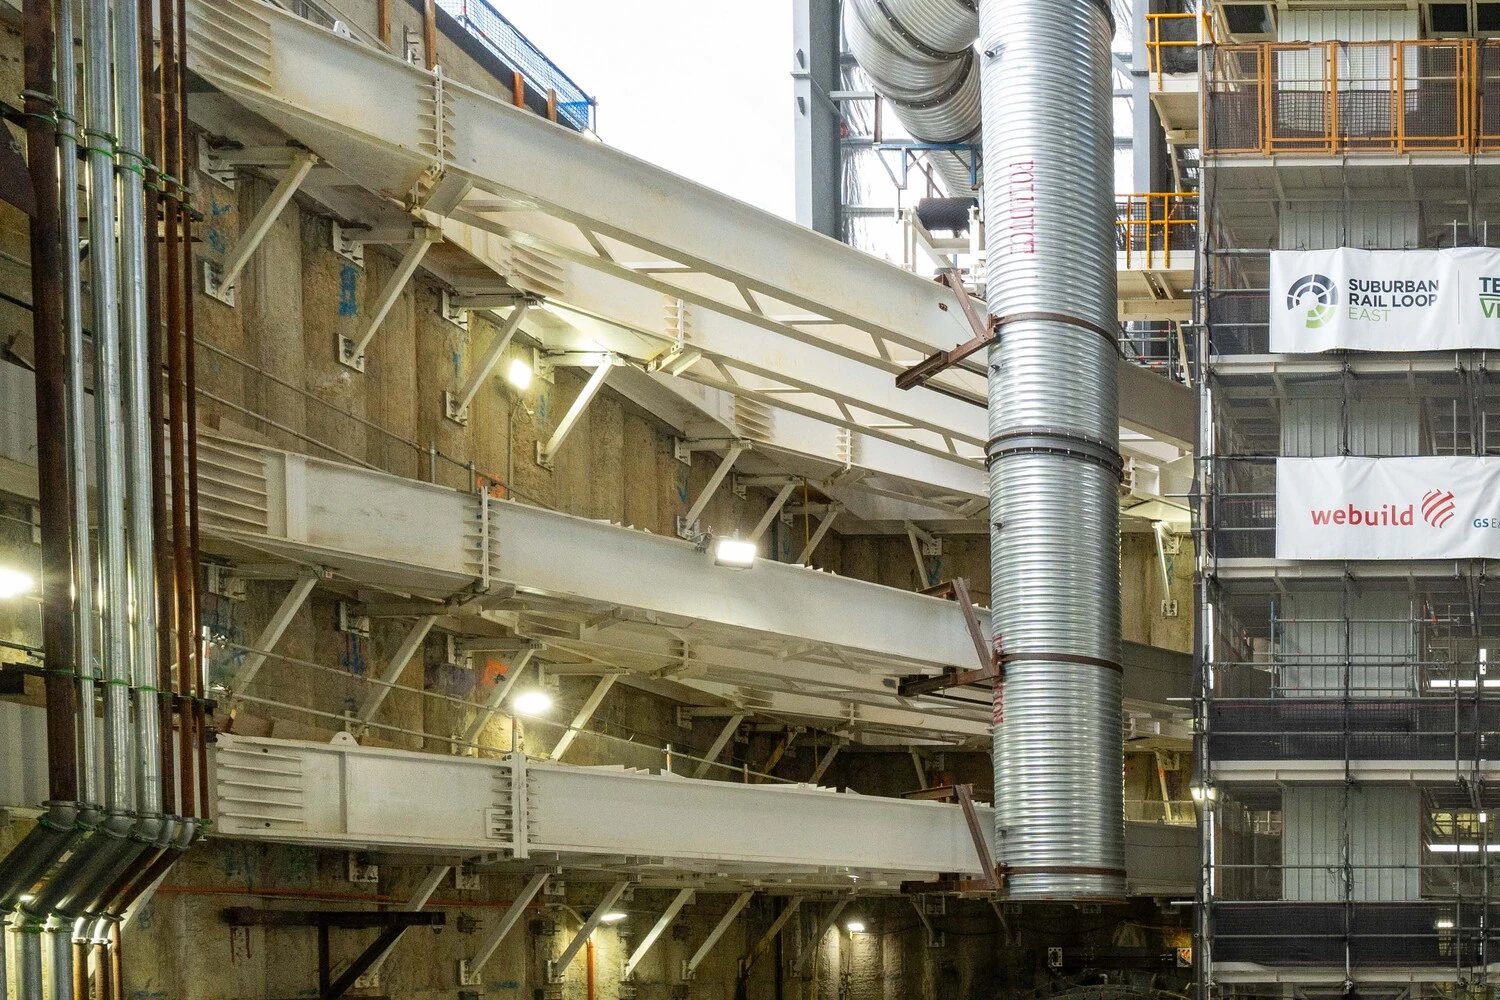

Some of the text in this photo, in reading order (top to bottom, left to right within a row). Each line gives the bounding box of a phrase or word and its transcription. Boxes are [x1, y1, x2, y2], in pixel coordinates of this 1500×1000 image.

[1348, 278, 1440, 293] SUBURBAN
[1349, 292, 1438, 308] RAIL LOOP
[1348, 307, 1391, 322] EAST
[1311, 504, 1414, 526] webuild
[1473, 518, 1489, 528] GS
